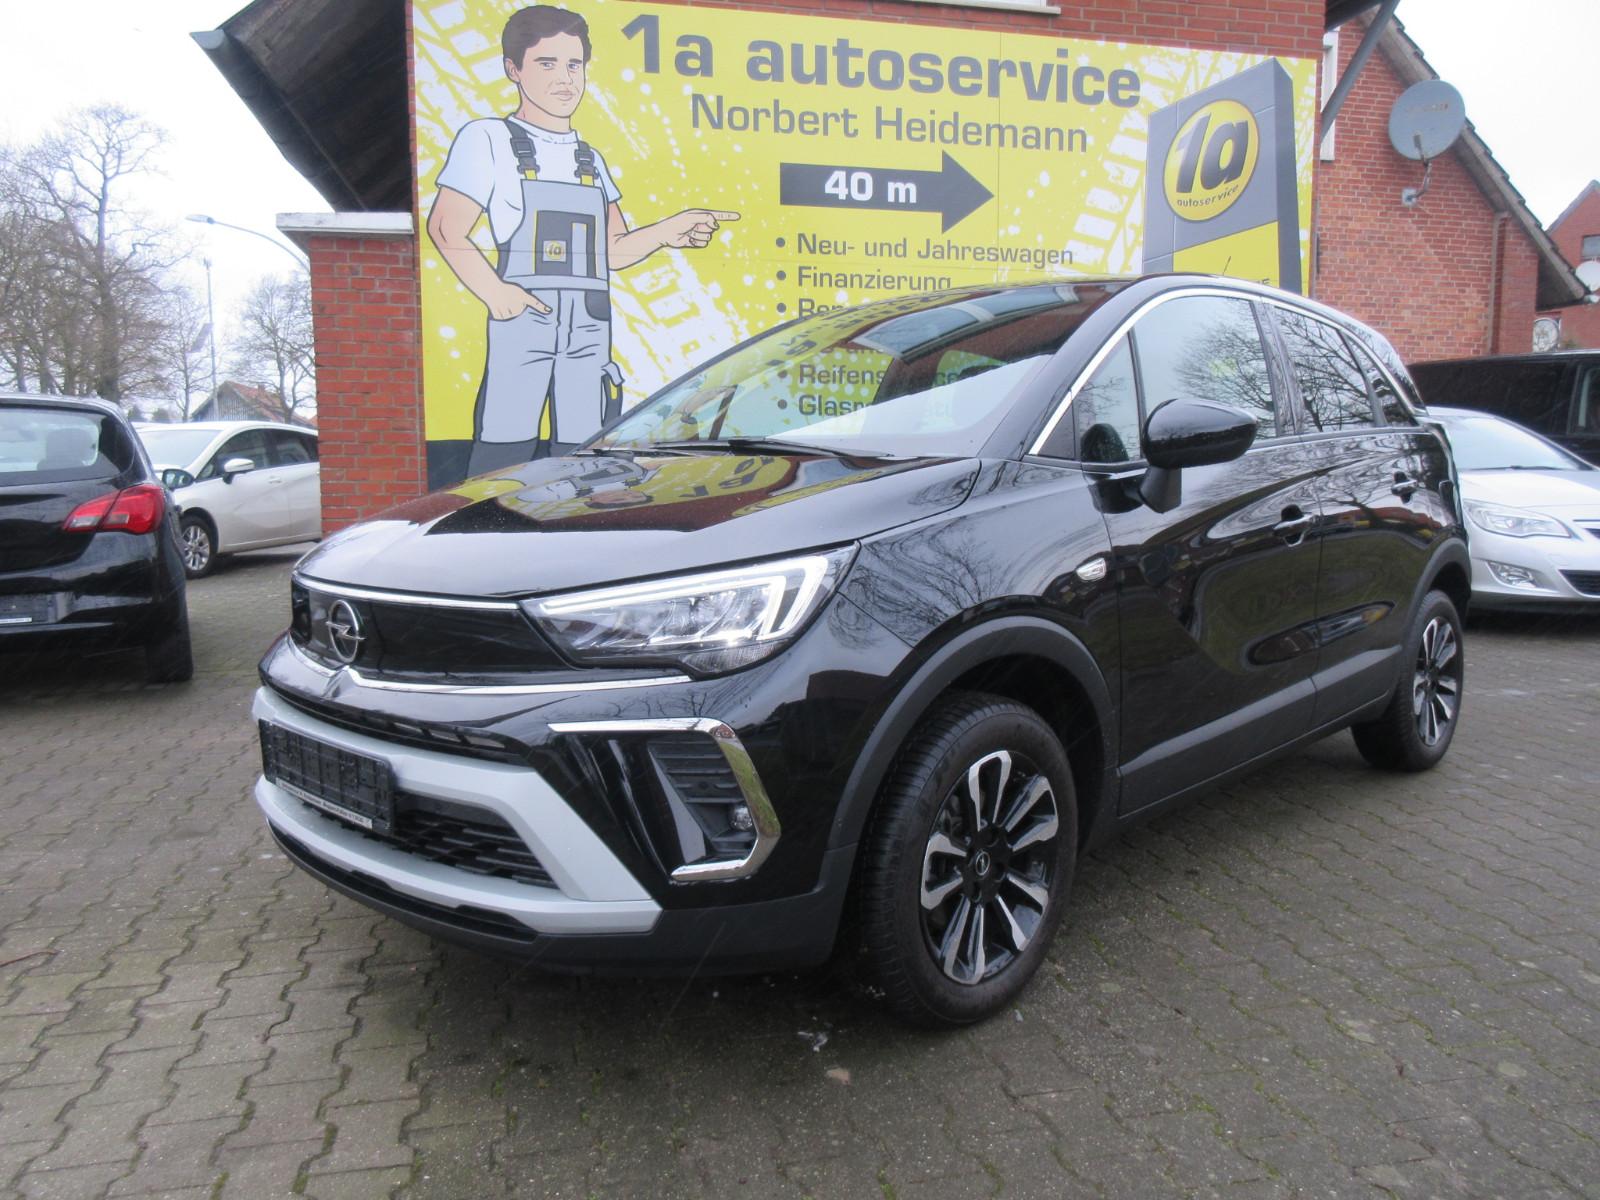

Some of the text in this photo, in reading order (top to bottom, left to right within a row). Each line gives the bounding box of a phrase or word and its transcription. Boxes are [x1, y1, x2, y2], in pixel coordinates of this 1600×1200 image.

[620, 14, 1141, 107] 1a autoservice
[691, 93, 1087, 152] Norbert Heidemann
[1175, 112, 1249, 194] 1a
[824, 170, 918, 203] 40 m
[1176, 184, 1240, 208] autoservice
[797, 232, 1074, 269] Neu- und Jahreswagen
[797, 265, 951, 291] Finanzierung
